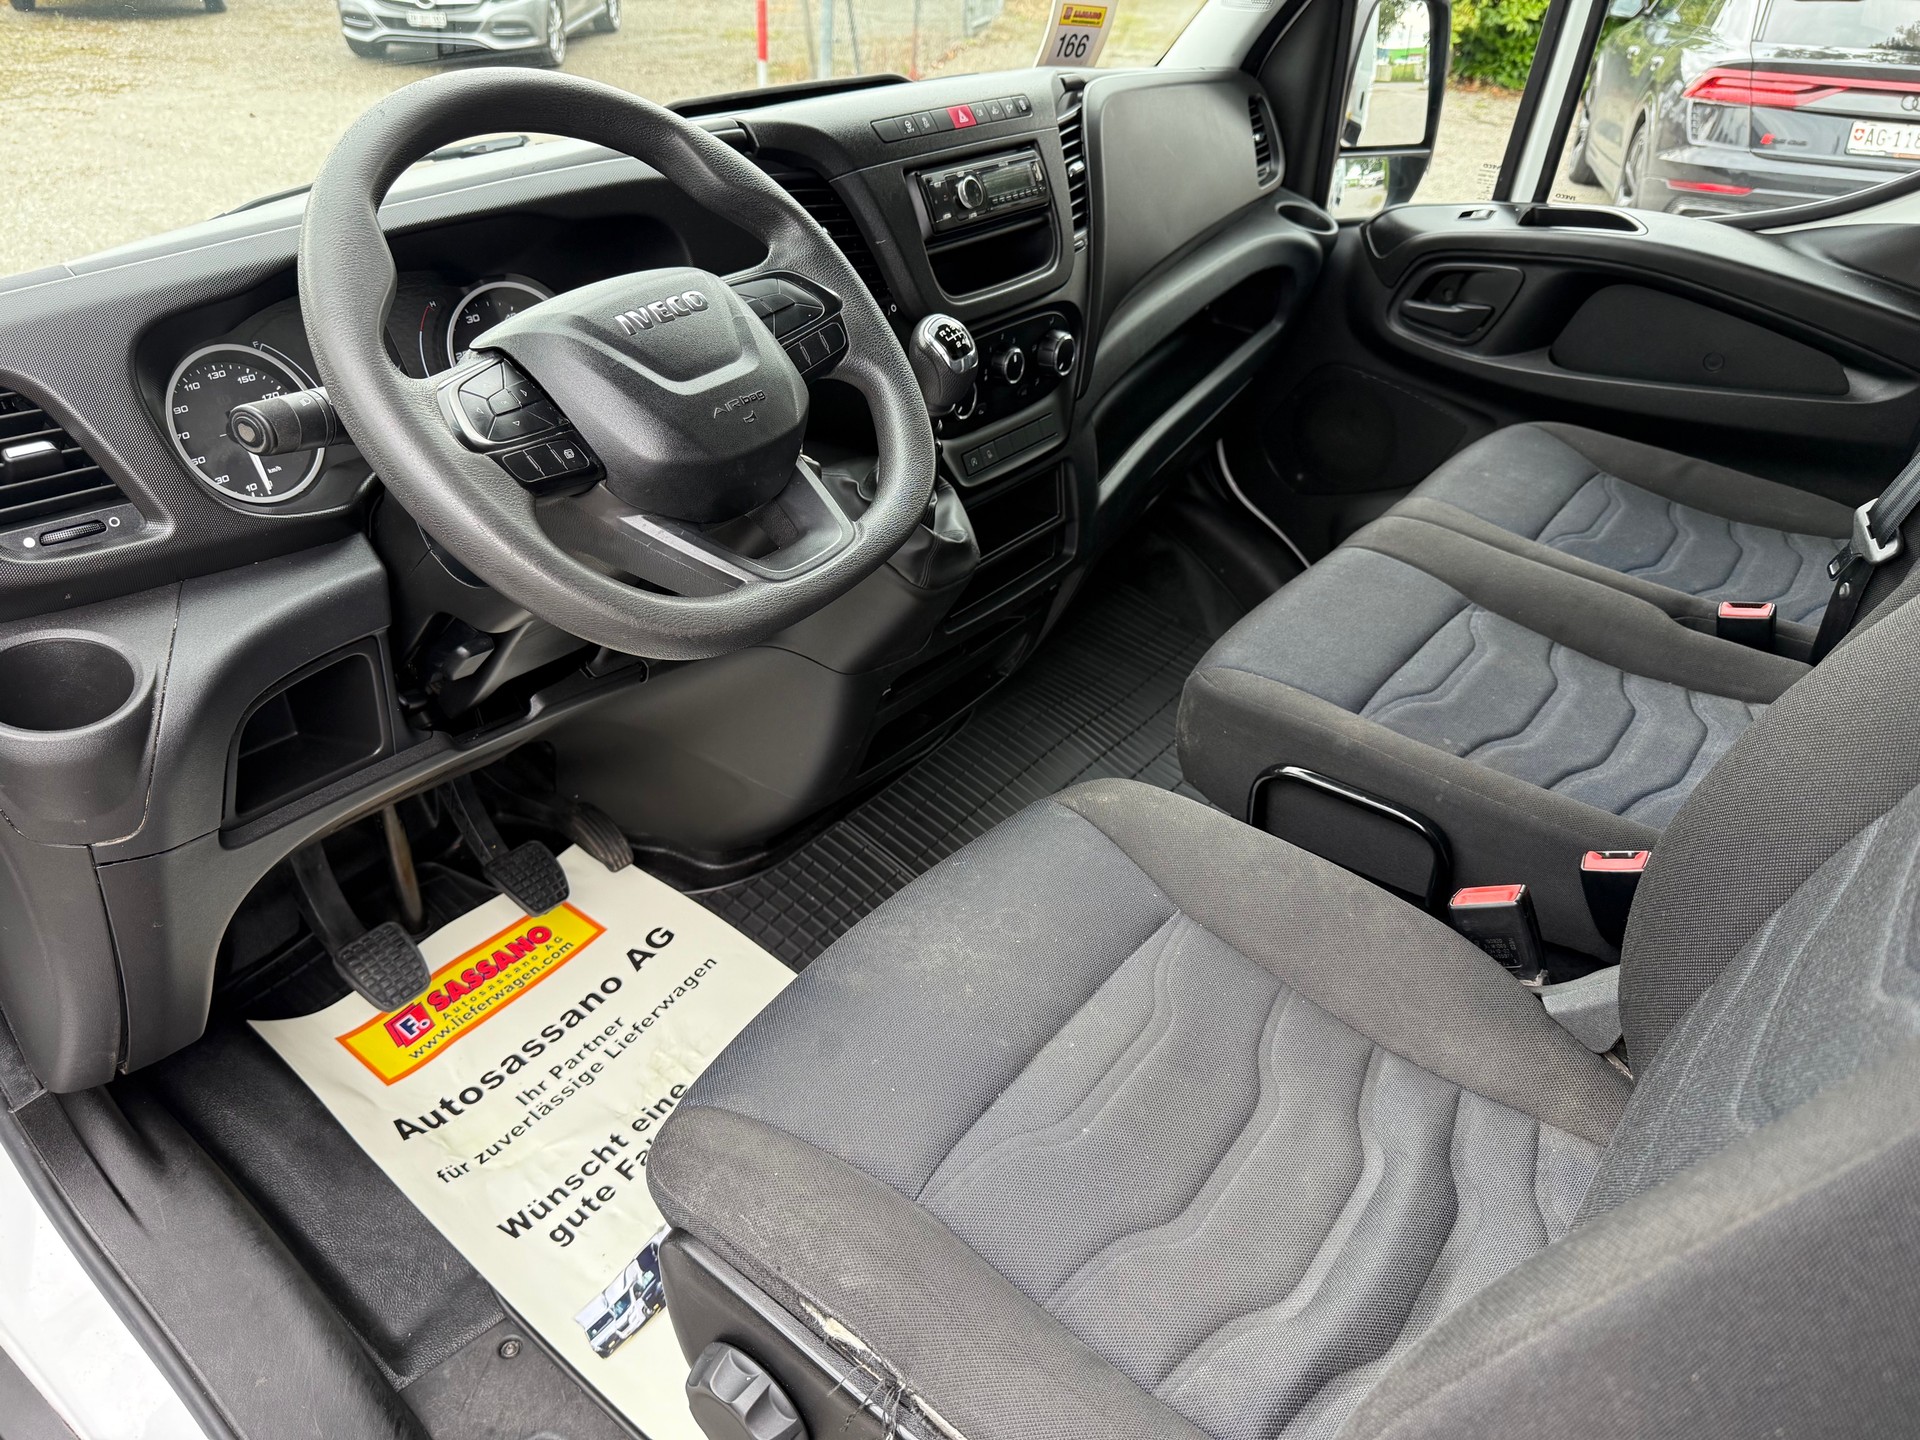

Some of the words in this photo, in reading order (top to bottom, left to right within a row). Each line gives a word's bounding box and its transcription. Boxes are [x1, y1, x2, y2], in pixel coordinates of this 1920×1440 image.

[1056, 33, 1090, 58] 166
[465, 313, 481, 324] 30
[613, 290, 709, 336] IVECO
[184, 381, 201, 392] 110
[207, 369, 227, 381] 130
[237, 373, 256, 385] 150
[173, 405, 189, 415] 90
[214, 474, 230, 486] 30
[245, 482, 258, 492] 10
[426, 926, 552, 1012] SASSANO
[442, 954, 538, 1020] Autosassano
[544, 935, 564, 951] AG
[409, 942, 574, 1059] www.lieferwagen.com
[393, 976, 622, 1141] Autosassano
[625, 926, 676, 972] AG
[437, 1161, 470, 1184] für
[474, 1060, 604, 1165] zuverlässige
[604, 956, 718, 1060] Lieferwagen
[515, 1080, 548, 1106] Ihr
[549, 1015, 625, 1080] Partner
[496, 1132, 629, 1239] Wünscht
[631, 1083, 688, 1132] eine
[549, 1185, 616, 1247] gute
[615, 1138, 652, 1181] Fa
